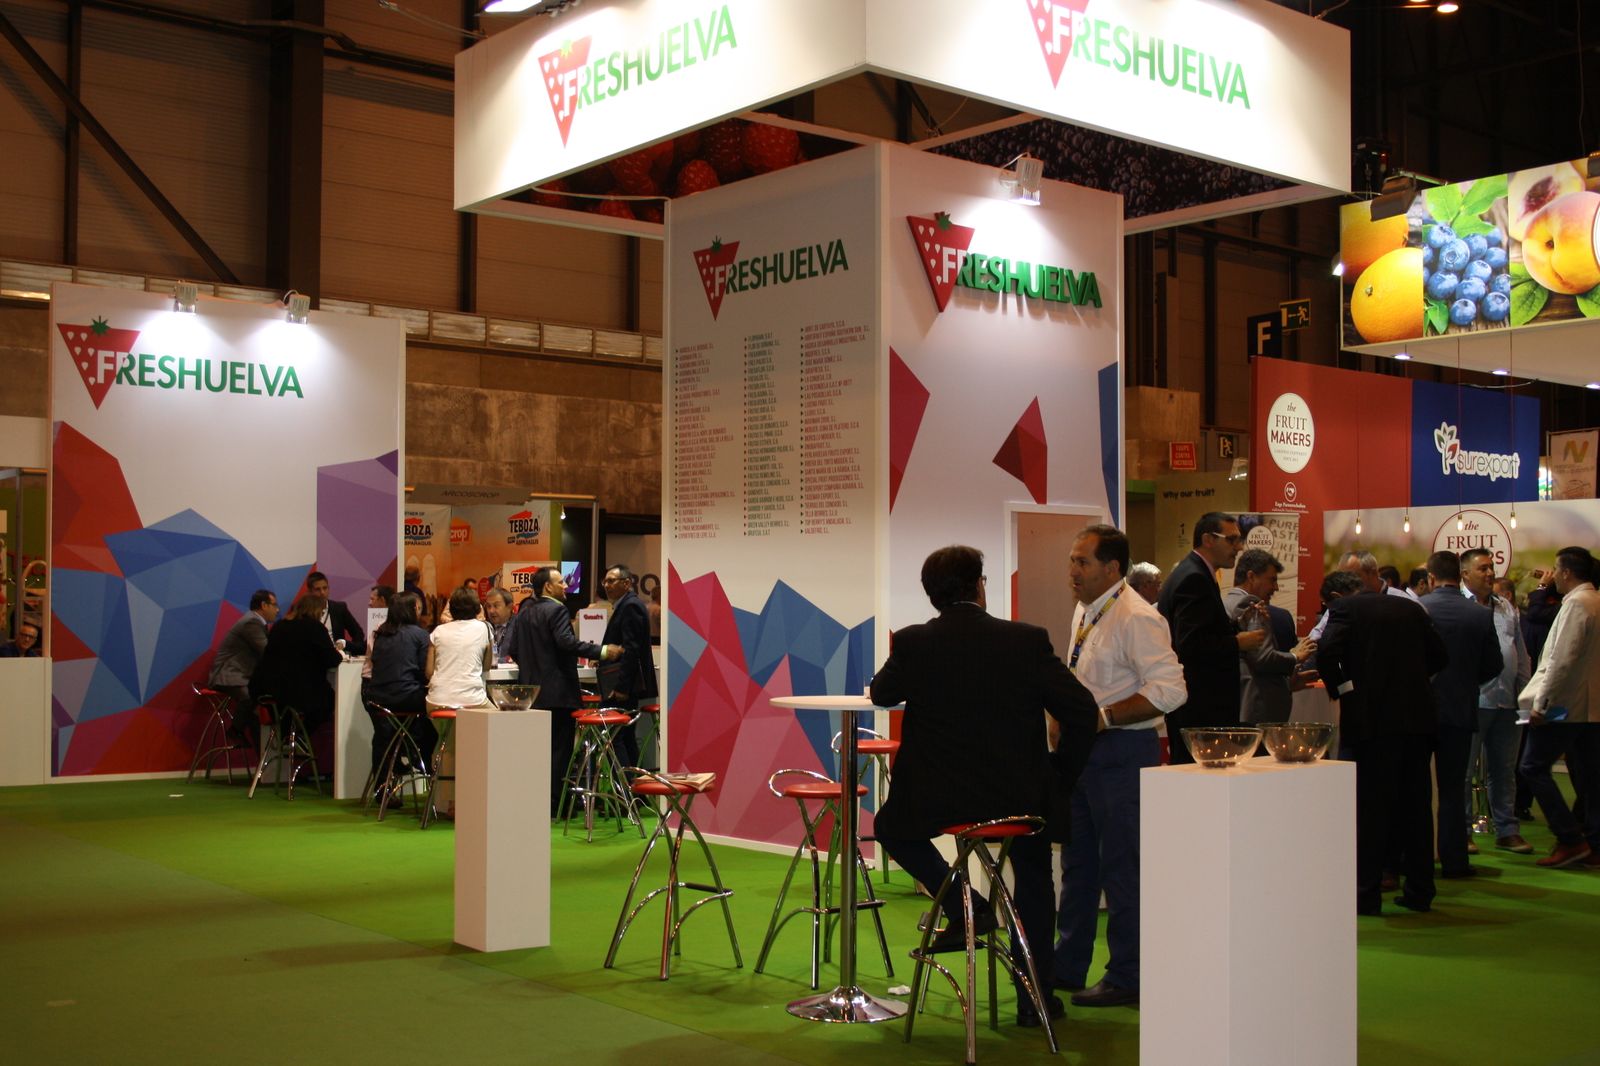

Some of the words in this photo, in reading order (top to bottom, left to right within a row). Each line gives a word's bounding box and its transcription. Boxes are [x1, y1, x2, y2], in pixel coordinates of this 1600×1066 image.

[564, 4, 738, 117] FRESHUELVA
[1052, 4, 1250, 110] FRESHUELVA
[714, 239, 848, 297] FRESHUELVA
[942, 246, 1102, 308] FRESHUELVA
[1257, 321, 1272, 354] F
[96, 350, 304, 398] FRESHUELVA
[1287, 402, 1296, 412] the
[1276, 415, 1307, 430] FRUIT
[1271, 430, 1311, 447] MAKERS
[1456, 452, 1519, 477] surexport
[510, 518, 538, 533] TEBOZA
[1464, 521, 1480, 531] the
[1446, 534, 1497, 549] FRUIT
[513, 573, 534, 584] TEB
